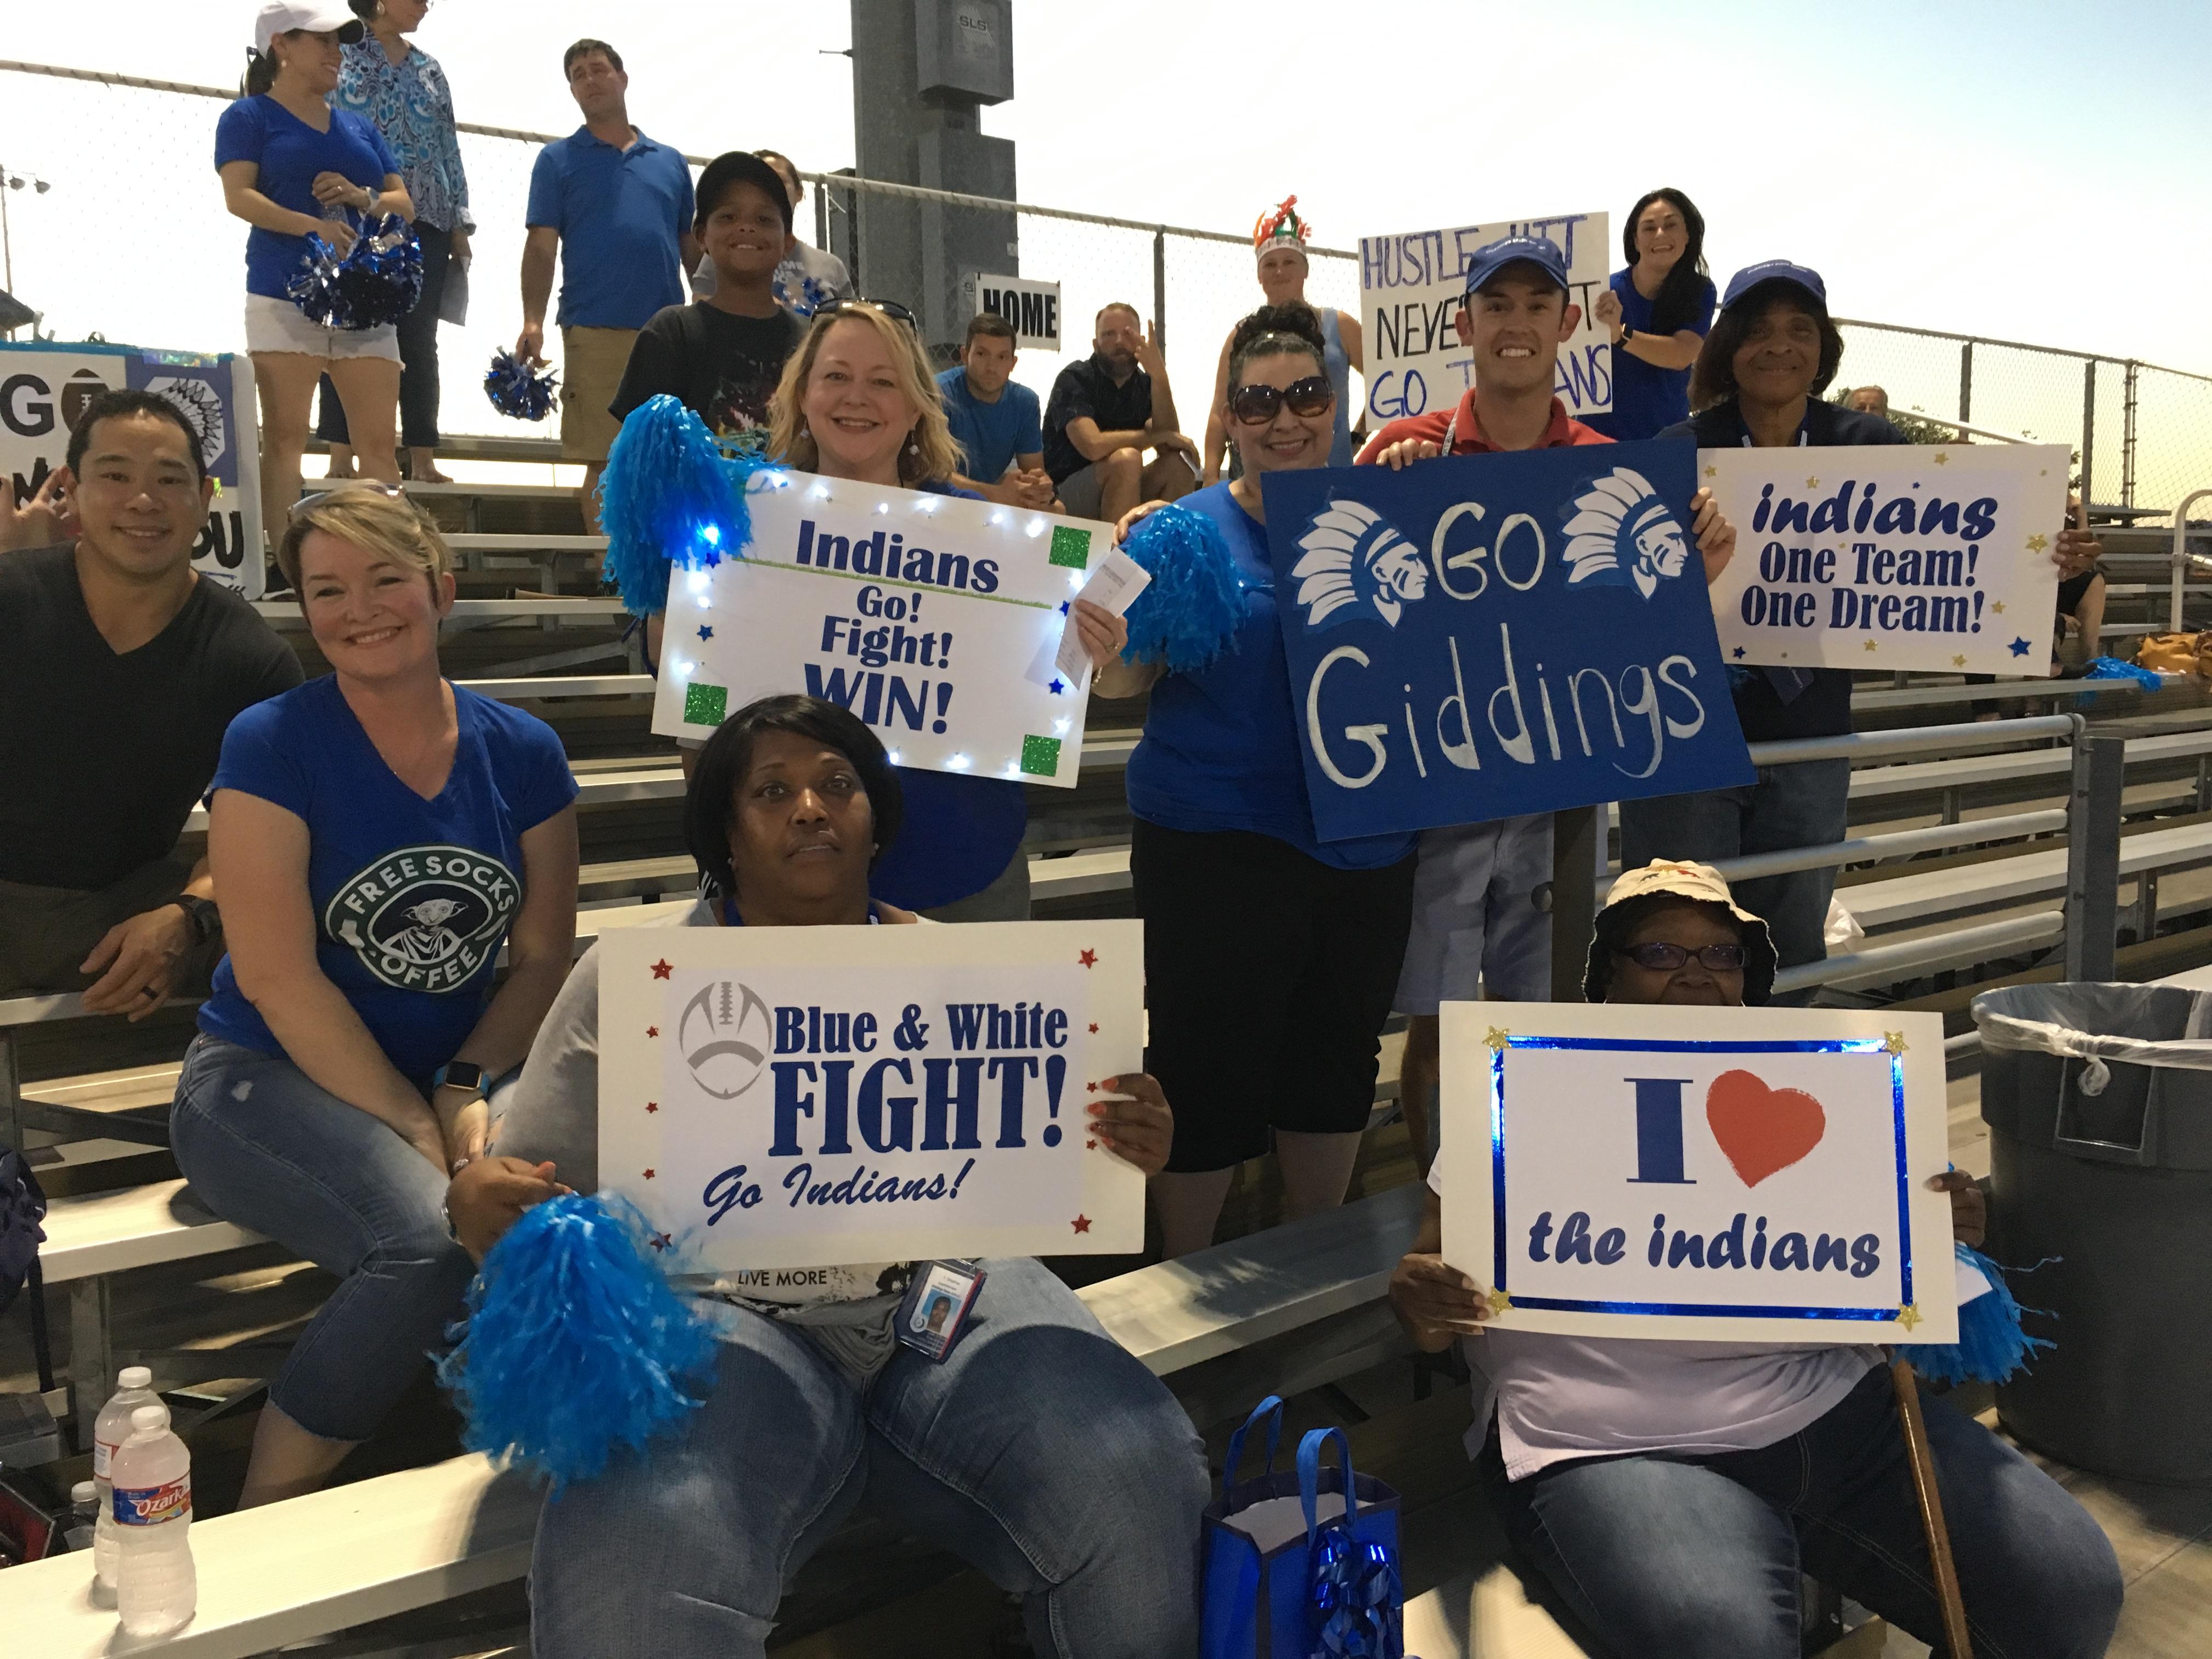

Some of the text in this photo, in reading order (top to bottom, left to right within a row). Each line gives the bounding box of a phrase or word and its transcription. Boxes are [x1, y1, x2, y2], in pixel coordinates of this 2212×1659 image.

[959, 16, 986, 31] SLS
[1362, 228, 1480, 290] HUSTLE
[983, 289, 1057, 339] HOME
[1370, 369, 1427, 419] GO
[1752, 480, 1998, 541] indians
[796, 520, 999, 594] Indians
[1432, 502, 1545, 600] GO
[1760, 541, 1979, 586] One Team!
[857, 585, 922, 623] Go!
[1741, 585, 1985, 633] One Dream!
[821, 614, 953, 668] Fight!
[804, 663, 953, 734] WIN!
[1307, 622, 1705, 789] Giddings
[344, 856, 515, 915] FREE SOCKS
[774, 1002, 1068, 1054] Blue & White
[768, 1054, 1067, 1157] FIGHT!
[1623, 1077, 1697, 1184] I
[703, 1158, 975, 1226] Go Indians!
[1528, 1210, 1881, 1278] the indians
[737, 1269, 827, 1287] LIVE MORE
